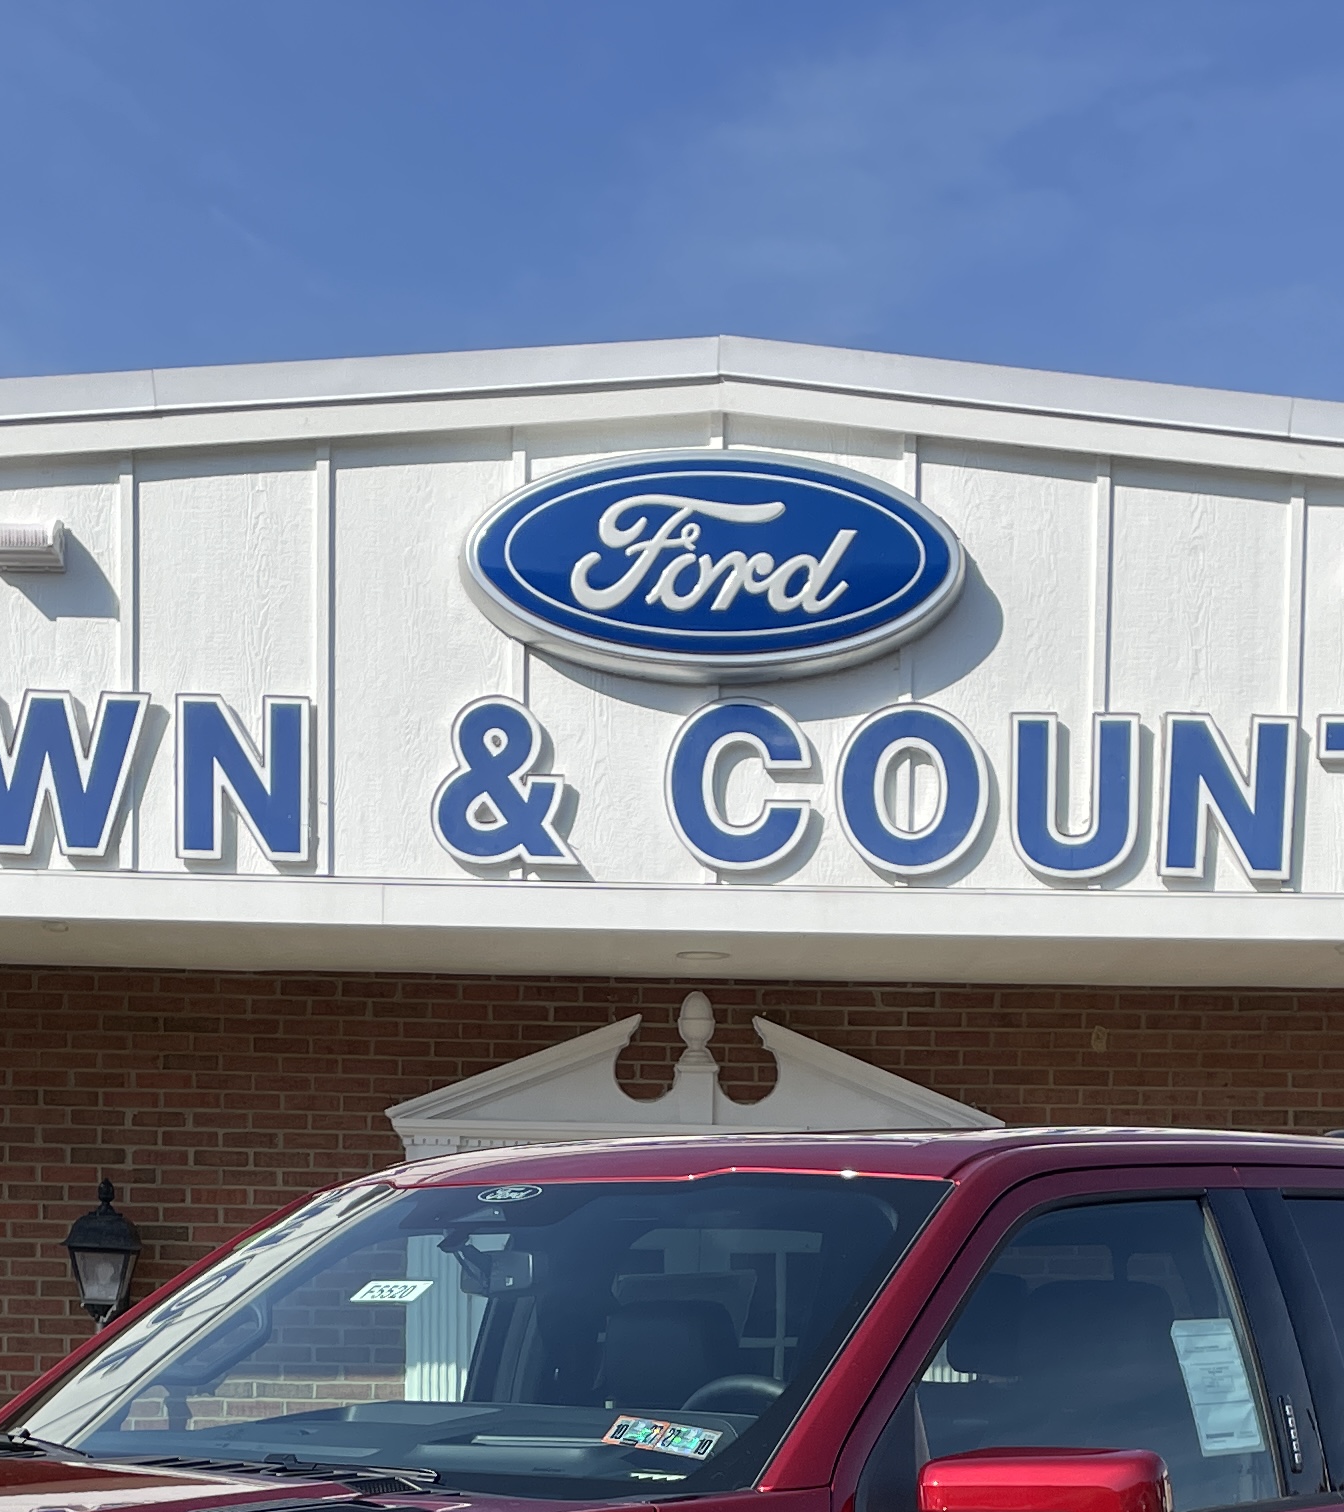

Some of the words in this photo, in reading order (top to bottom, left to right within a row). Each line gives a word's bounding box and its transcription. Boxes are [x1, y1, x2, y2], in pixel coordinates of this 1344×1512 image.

[569, 493, 859, 614] Ford
[431, 694, 582, 867] &
[359, 1284, 418, 1299] F5520
[610, 1424, 630, 1440] 10
[693, 1438, 714, 1455] 10
